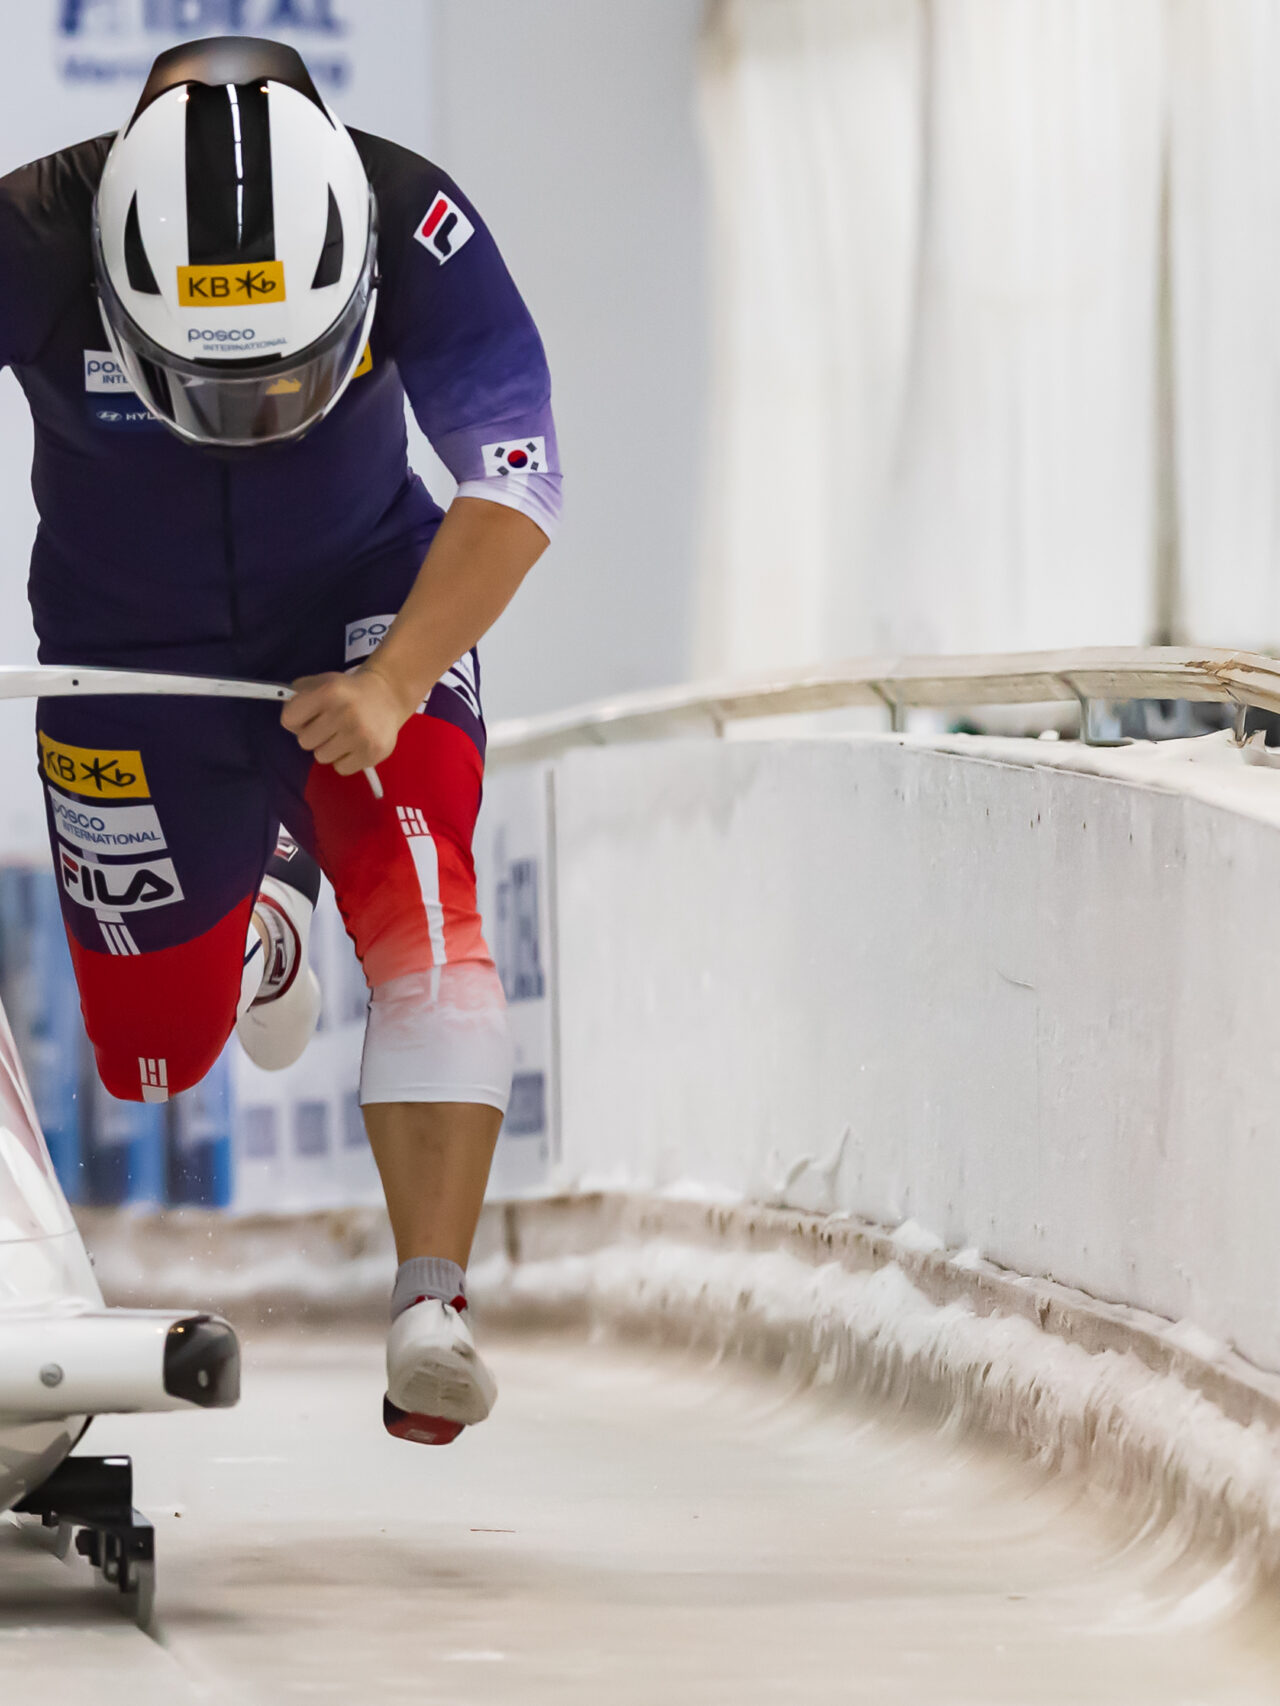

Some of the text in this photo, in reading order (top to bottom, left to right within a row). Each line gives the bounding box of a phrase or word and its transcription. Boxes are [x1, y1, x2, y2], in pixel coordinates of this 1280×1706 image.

[202, 336, 289, 352] INTERNATIONAL
[62, 820, 162, 846] INTERNATIONAL
[61, 852, 175, 907] FILA
